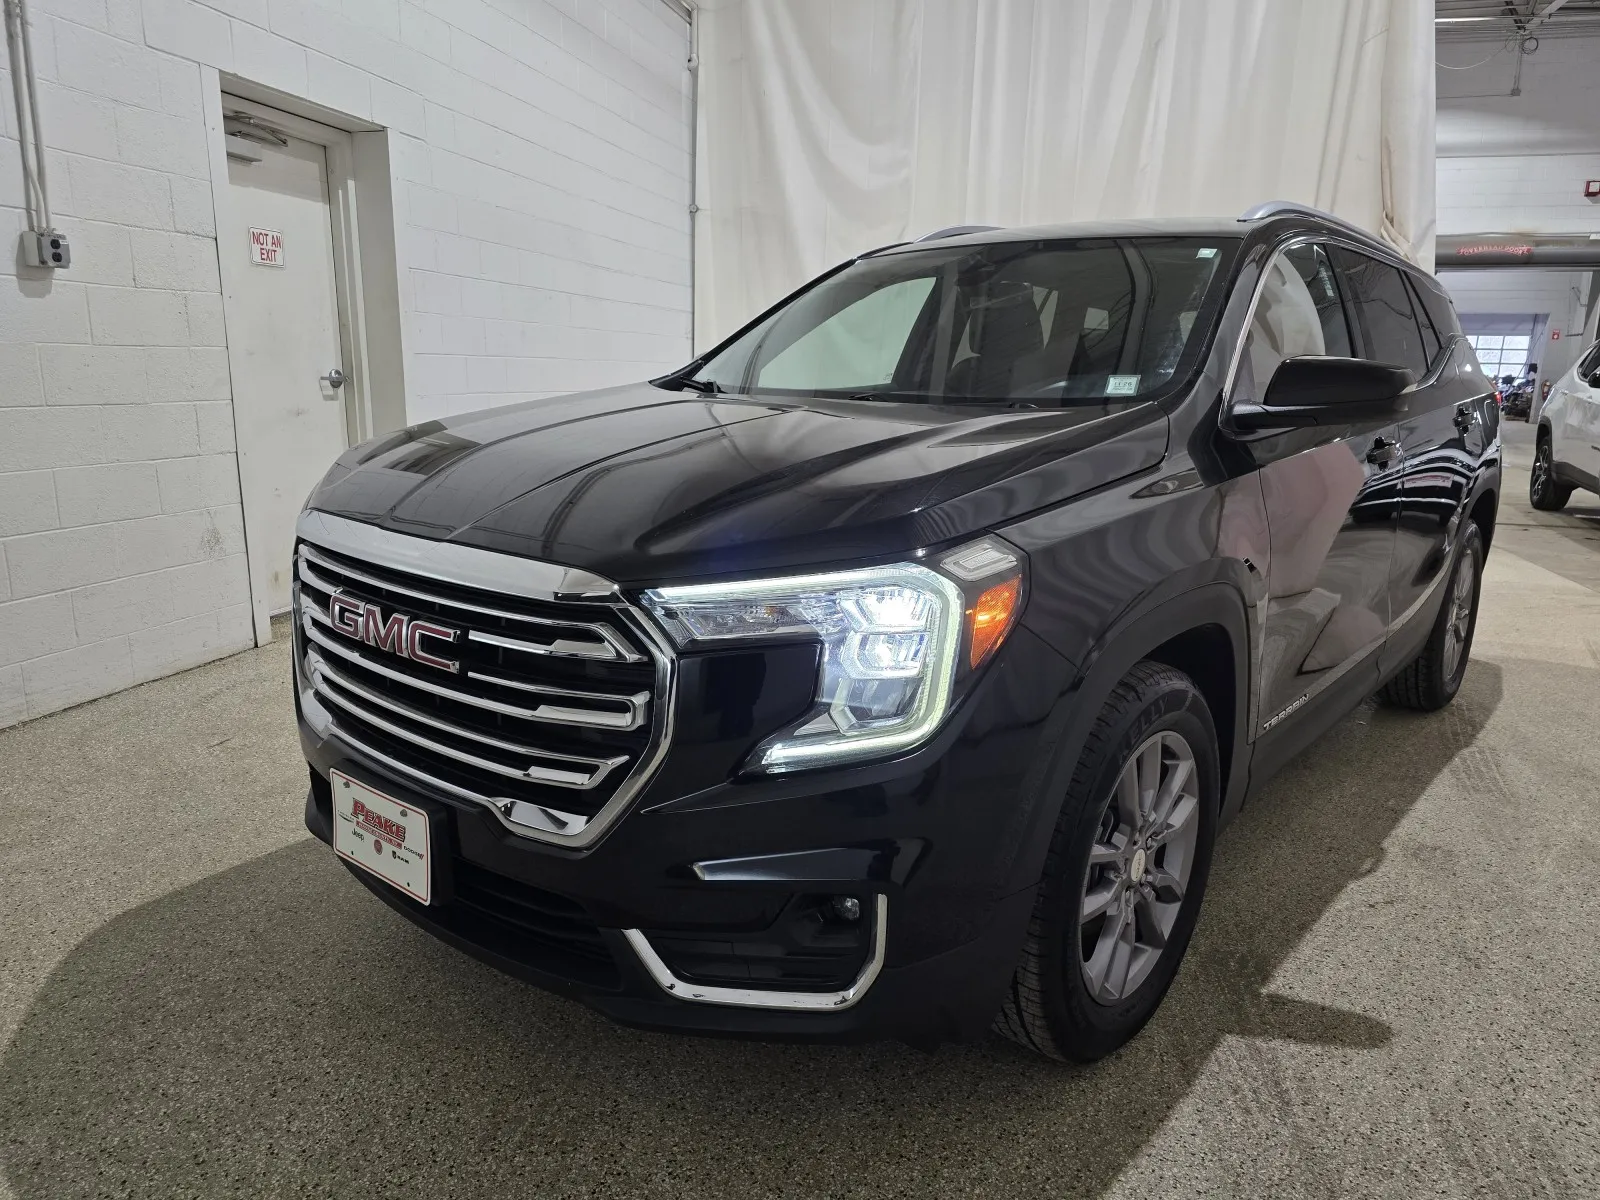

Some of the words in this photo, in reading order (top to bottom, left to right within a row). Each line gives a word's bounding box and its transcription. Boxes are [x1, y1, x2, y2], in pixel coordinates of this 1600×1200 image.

[252, 231, 269, 246] NOT
[271, 235, 281, 249] AN
[260, 248, 277, 262] EXIT
[330, 594, 460, 674] GMC
[1263, 693, 1309, 731] TERRAIN
[351, 797, 406, 842] PEAKE
